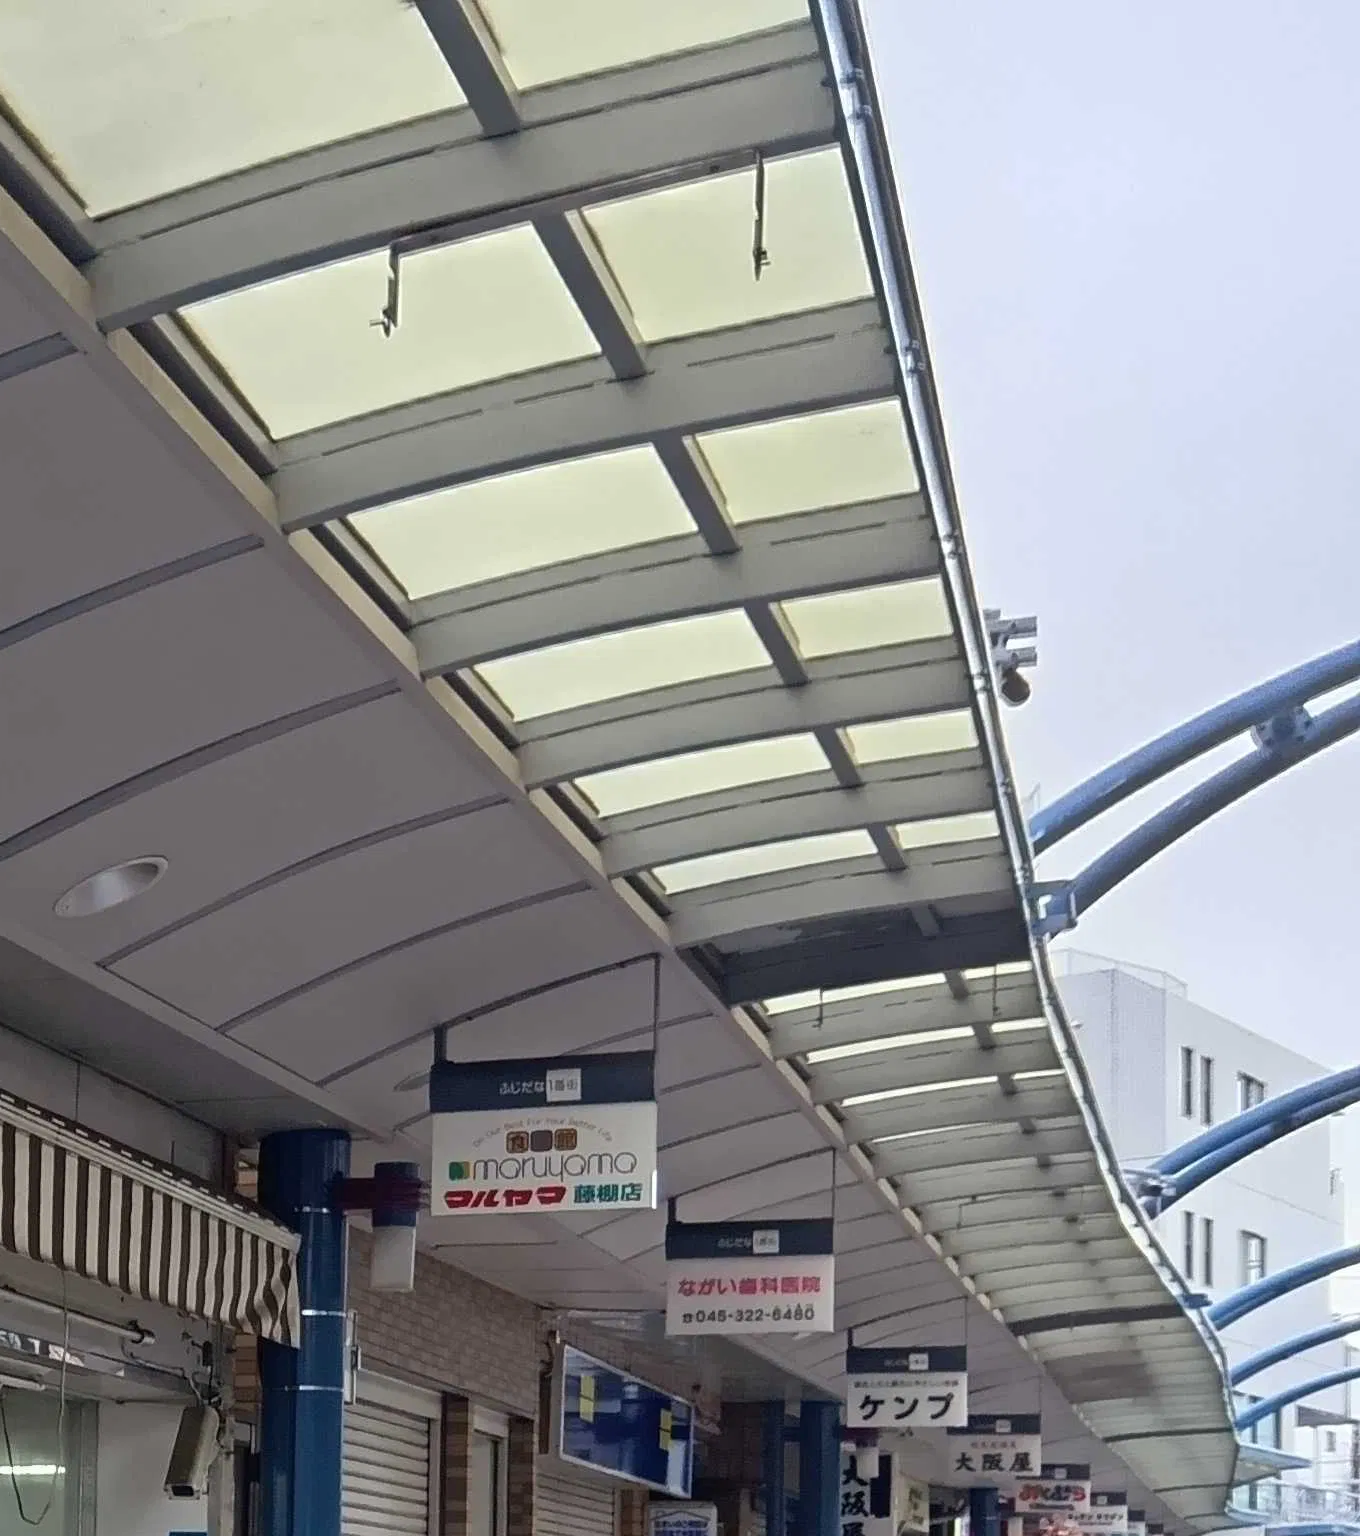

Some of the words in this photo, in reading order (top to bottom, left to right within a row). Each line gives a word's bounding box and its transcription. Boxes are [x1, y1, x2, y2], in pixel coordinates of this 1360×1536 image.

[499, 1079, 545, 1096] ふじだな
[472, 1151, 638, 1182] maruyama
[443, 1185, 567, 1209] マルヤマ
[573, 1182, 643, 1204] 藤棚店
[678, 1276, 821, 1297] ながい歯科医院
[859, 1392, 955, 1421] ケンプ
[954, 1451, 1034, 1473] 大阪屋
